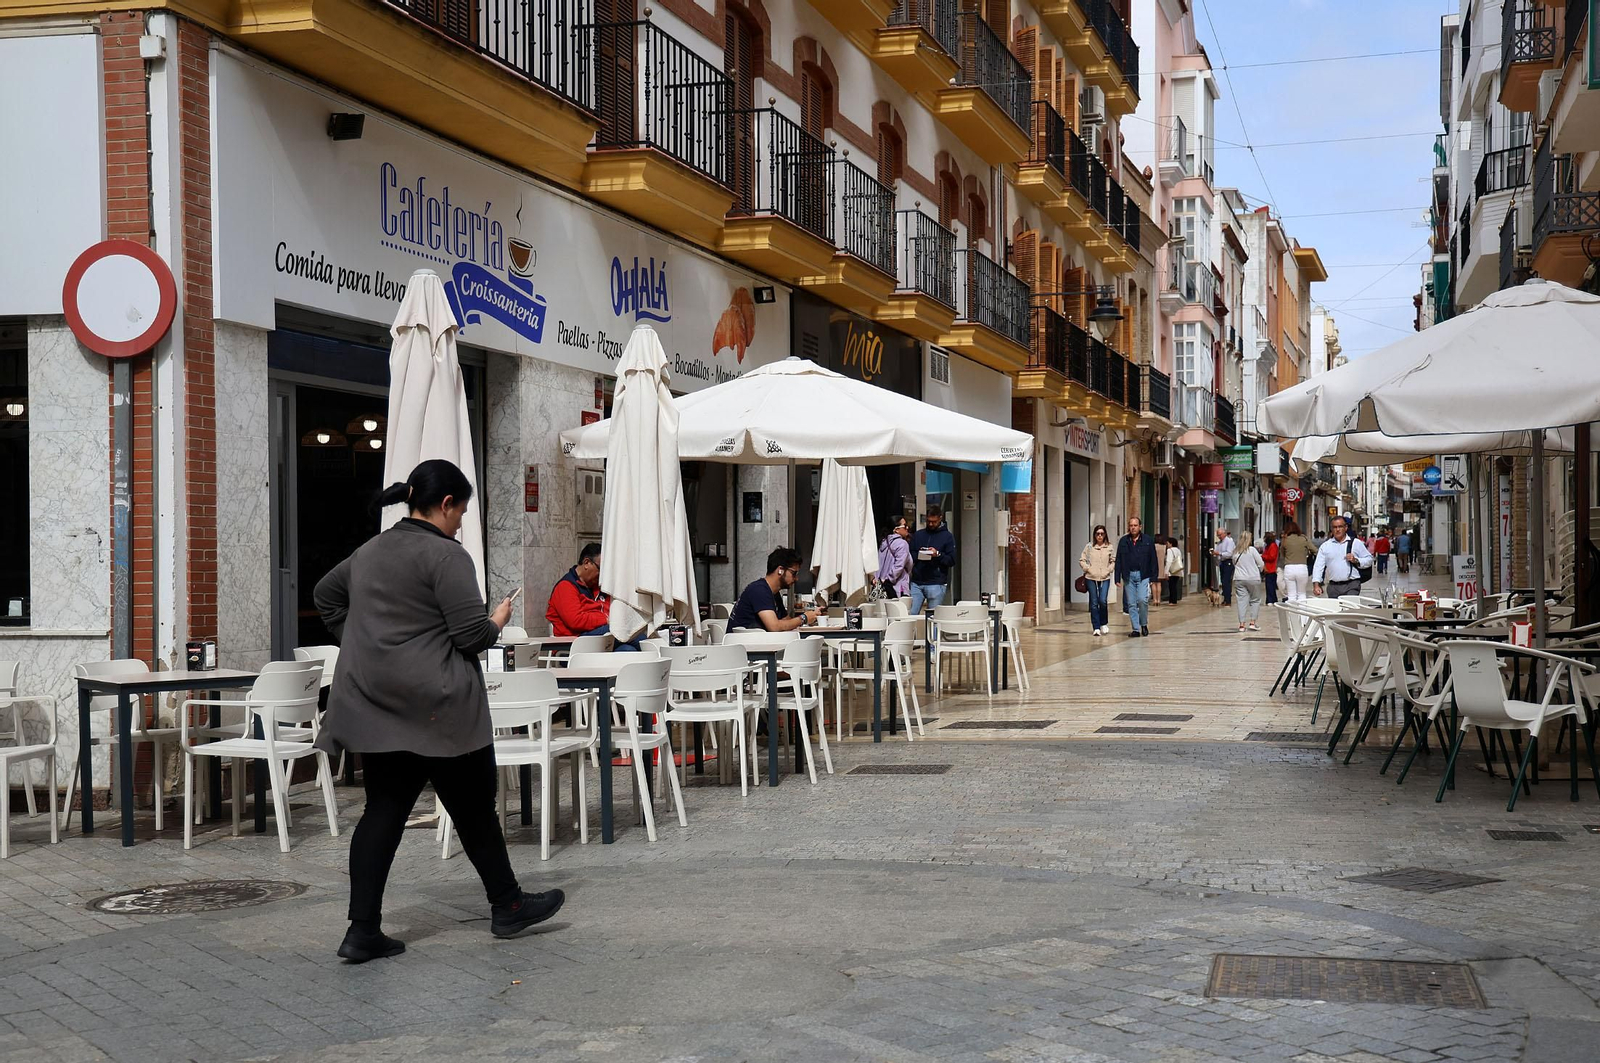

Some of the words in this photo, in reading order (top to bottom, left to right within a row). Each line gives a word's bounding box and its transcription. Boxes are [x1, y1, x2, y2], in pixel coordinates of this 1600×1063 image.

[380, 162, 504, 271] Cafetería
[275, 241, 334, 285] Comida
[337, 266, 371, 294] para
[375, 270, 409, 303] lleva
[460, 273, 539, 330] Croissanteria
[558, 320, 589, 350] Paellas
[597, 331, 623, 361] Pizzas
[675, 353, 710, 381] Bocadillos
[1070, 424, 1099, 455] INTERSPORT
